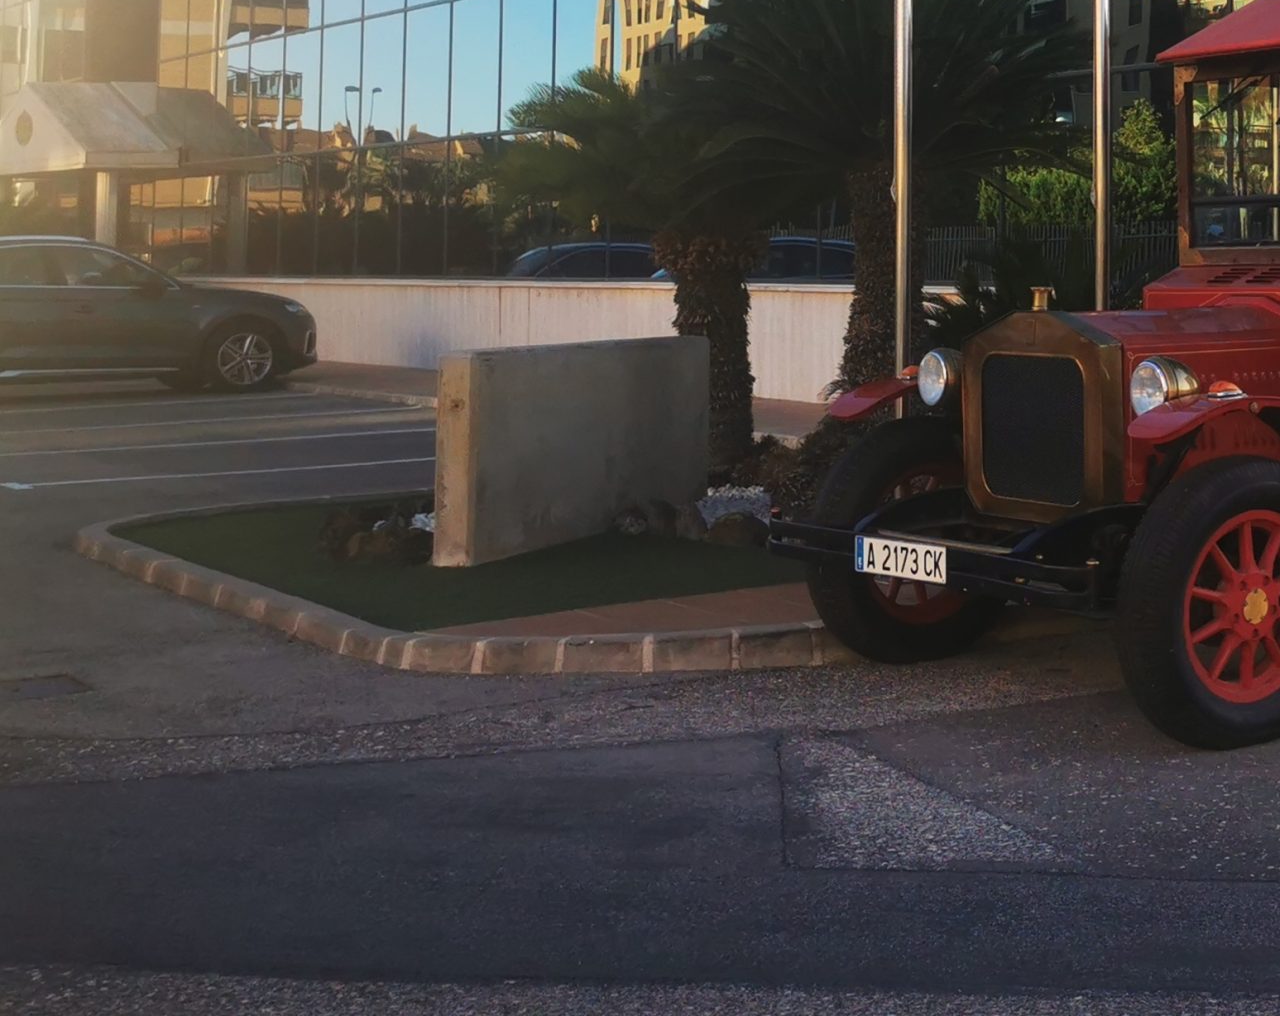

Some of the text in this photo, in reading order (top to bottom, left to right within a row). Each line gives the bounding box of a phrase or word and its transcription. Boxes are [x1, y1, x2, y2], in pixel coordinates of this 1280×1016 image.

[866, 542, 876, 570] A
[881, 544, 919, 575] 2173
[923, 550, 944, 579] CK
